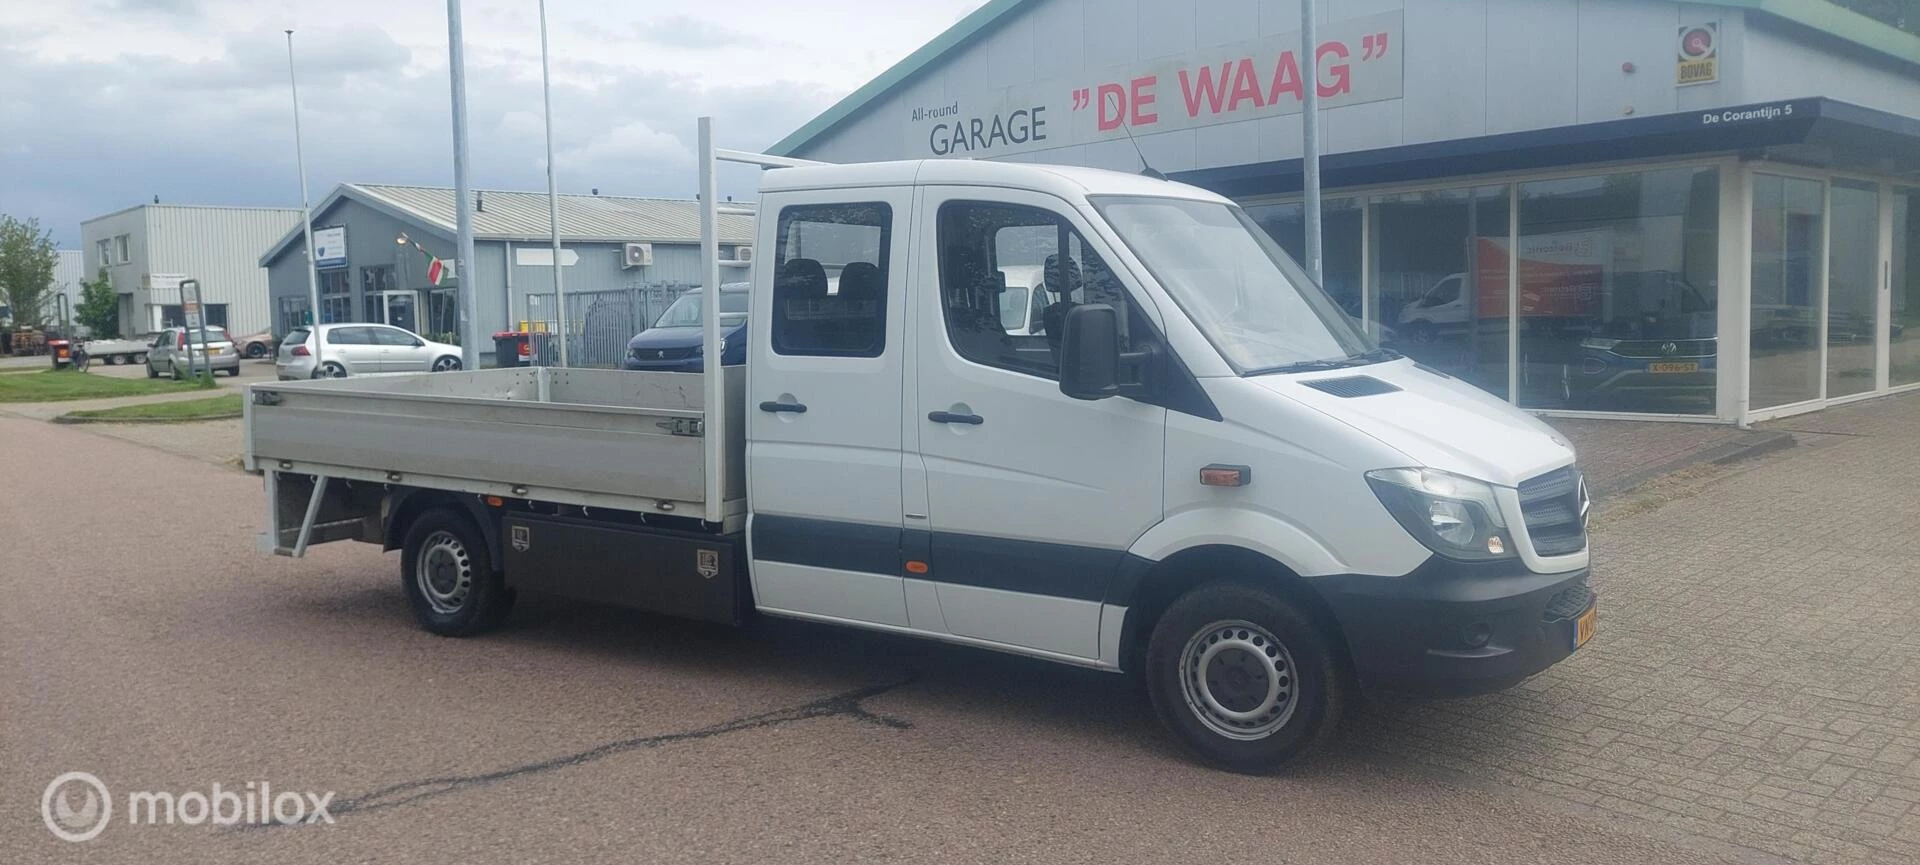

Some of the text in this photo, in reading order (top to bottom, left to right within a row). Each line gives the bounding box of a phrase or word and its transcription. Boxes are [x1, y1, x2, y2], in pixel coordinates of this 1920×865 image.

[1680, 62, 1713, 80] BOVAG
[911, 101, 959, 121] All-round
[1703, 104, 1793, 124] De Corantijn 5
[929, 105, 1047, 156] GARAGE
